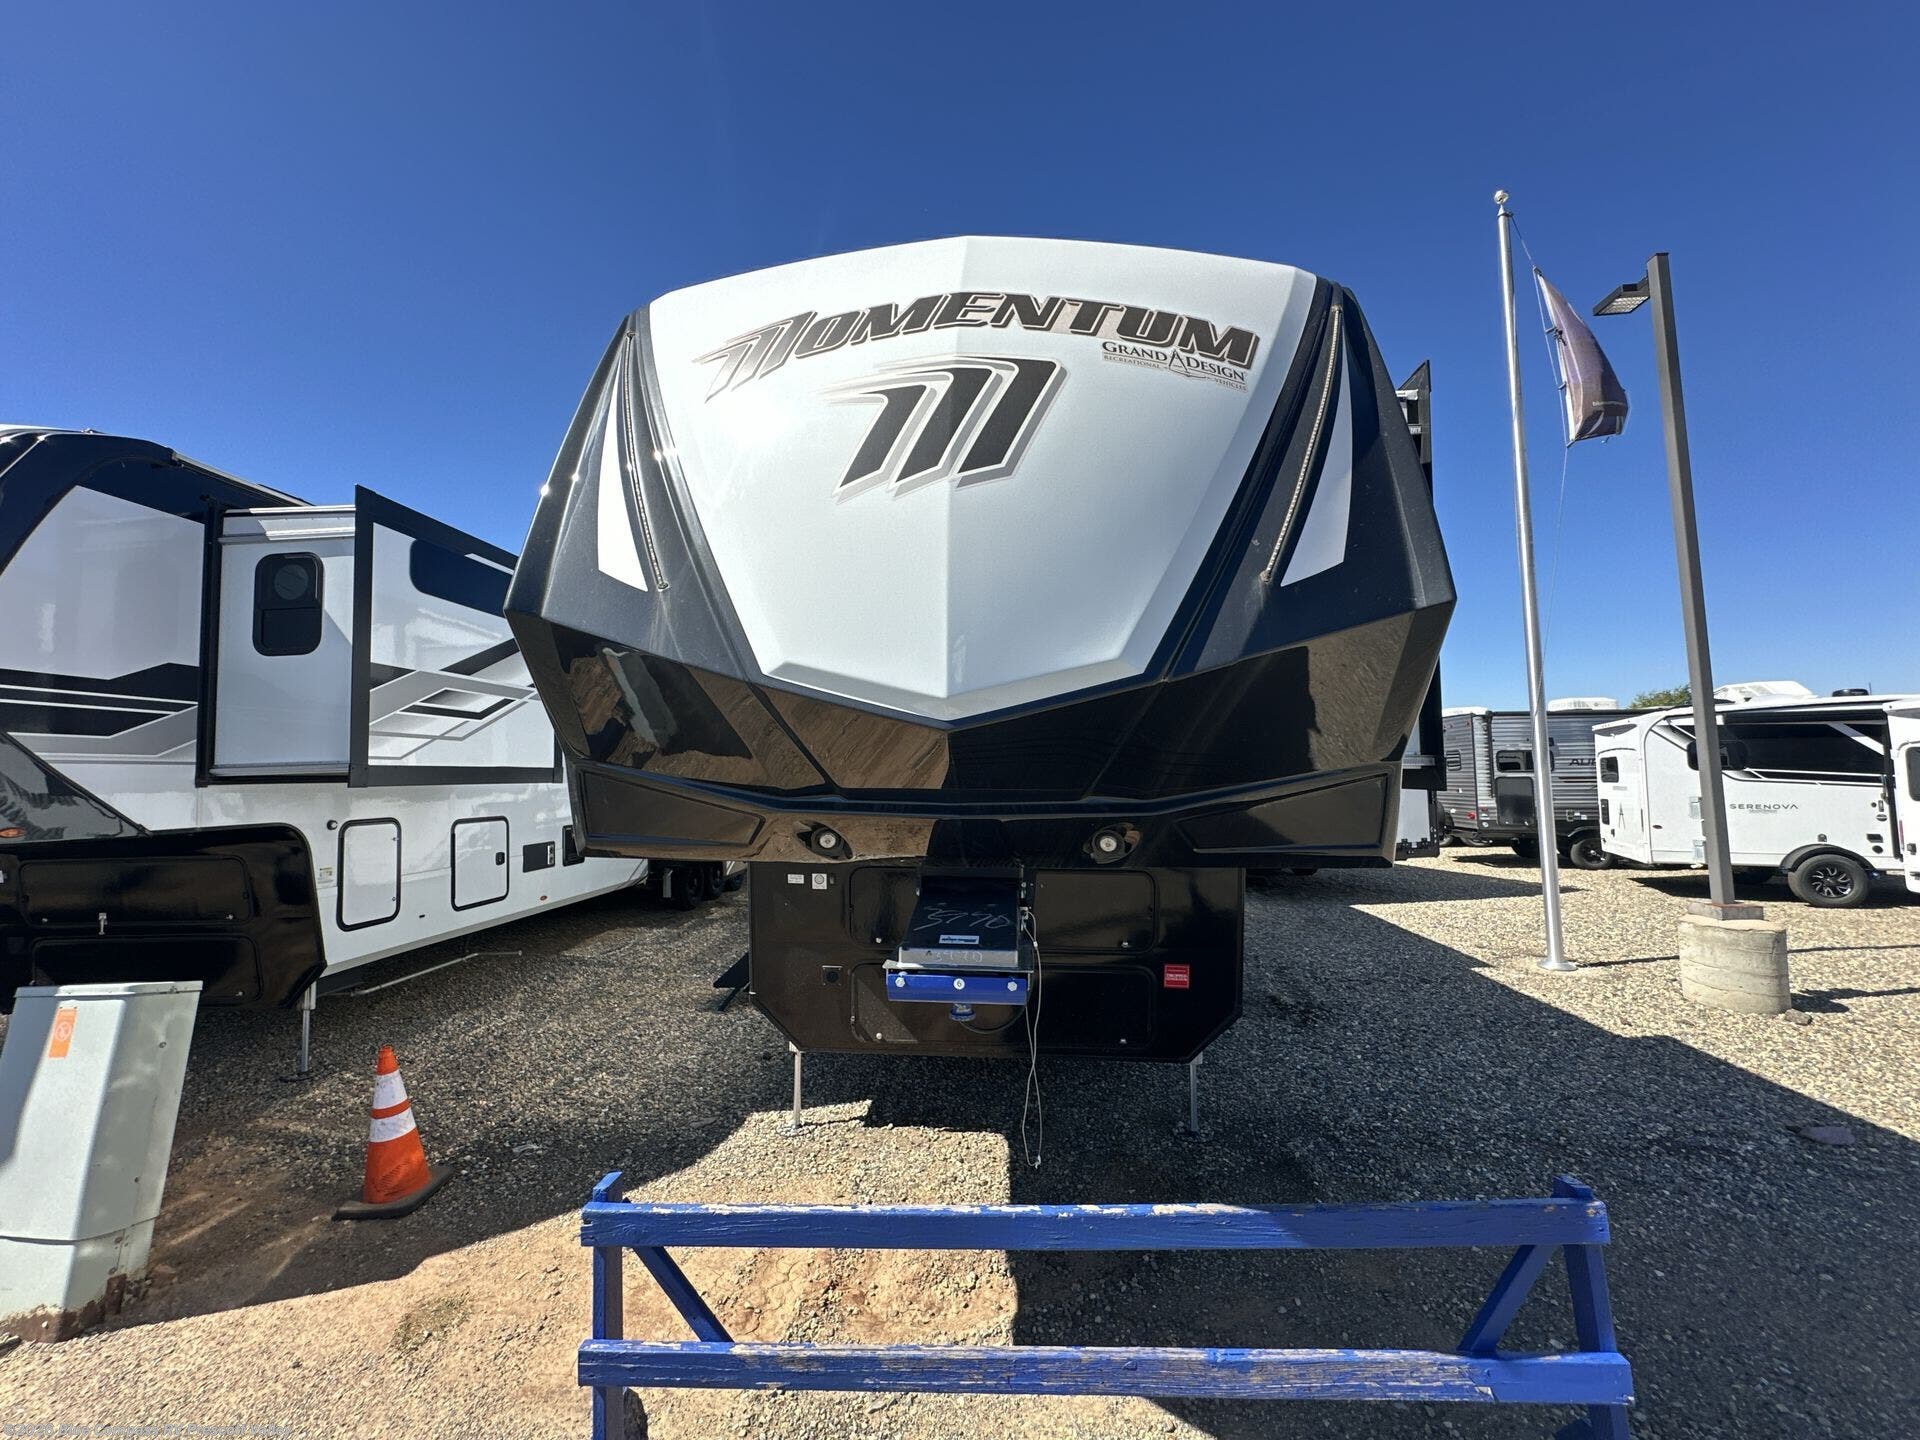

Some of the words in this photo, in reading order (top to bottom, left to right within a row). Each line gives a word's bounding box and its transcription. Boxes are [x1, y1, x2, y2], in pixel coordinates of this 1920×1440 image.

[693, 290, 1260, 402] MOMENTUM
[1102, 341, 1168, 361] GRAND
[1186, 356, 1246, 381] DESIGN
